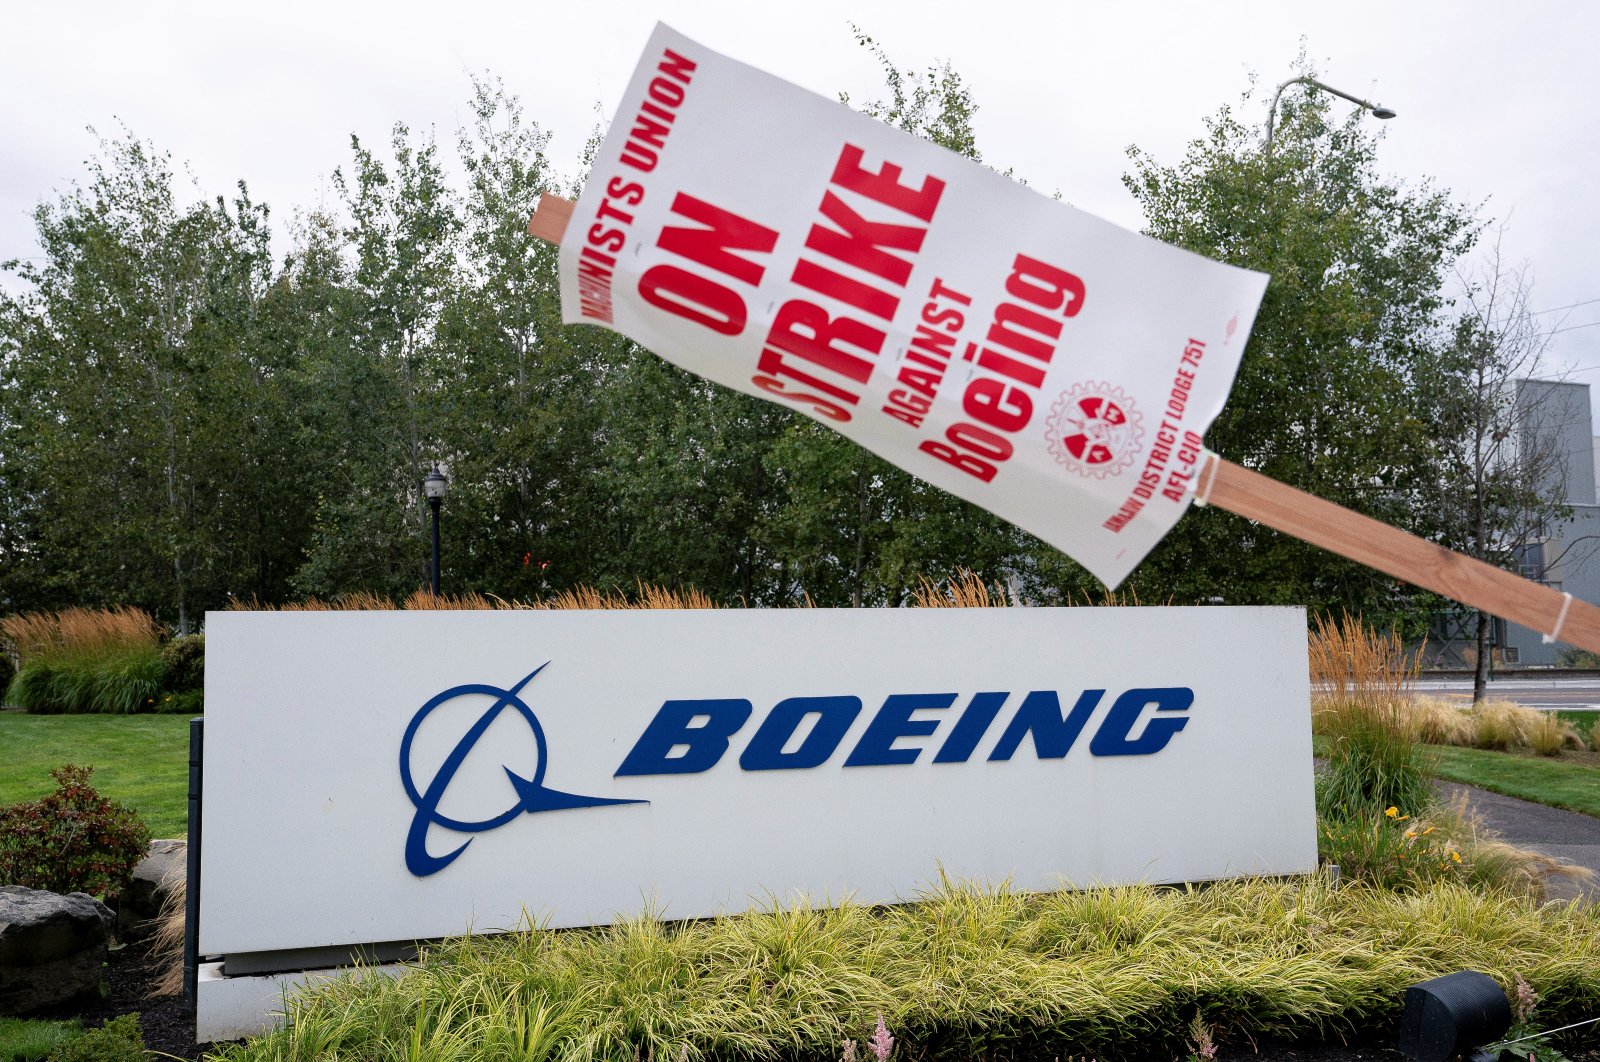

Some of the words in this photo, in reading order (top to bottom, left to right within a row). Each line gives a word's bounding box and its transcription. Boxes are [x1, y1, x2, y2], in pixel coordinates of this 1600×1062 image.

[619, 48, 698, 174] UNION
[638, 190, 780, 337] ON
[751, 142, 946, 424] STRIKE
[881, 277, 973, 430] AGAINST
[918, 253, 1087, 485] Boeing
[1166, 367, 1196, 422] LODGE
[1180, 337, 1207, 369] 751
[1132, 419, 1178, 500] DISTRICT
[1162, 430, 1202, 502] AFL-CIO
[614, 687, 1194, 777] BOEING
